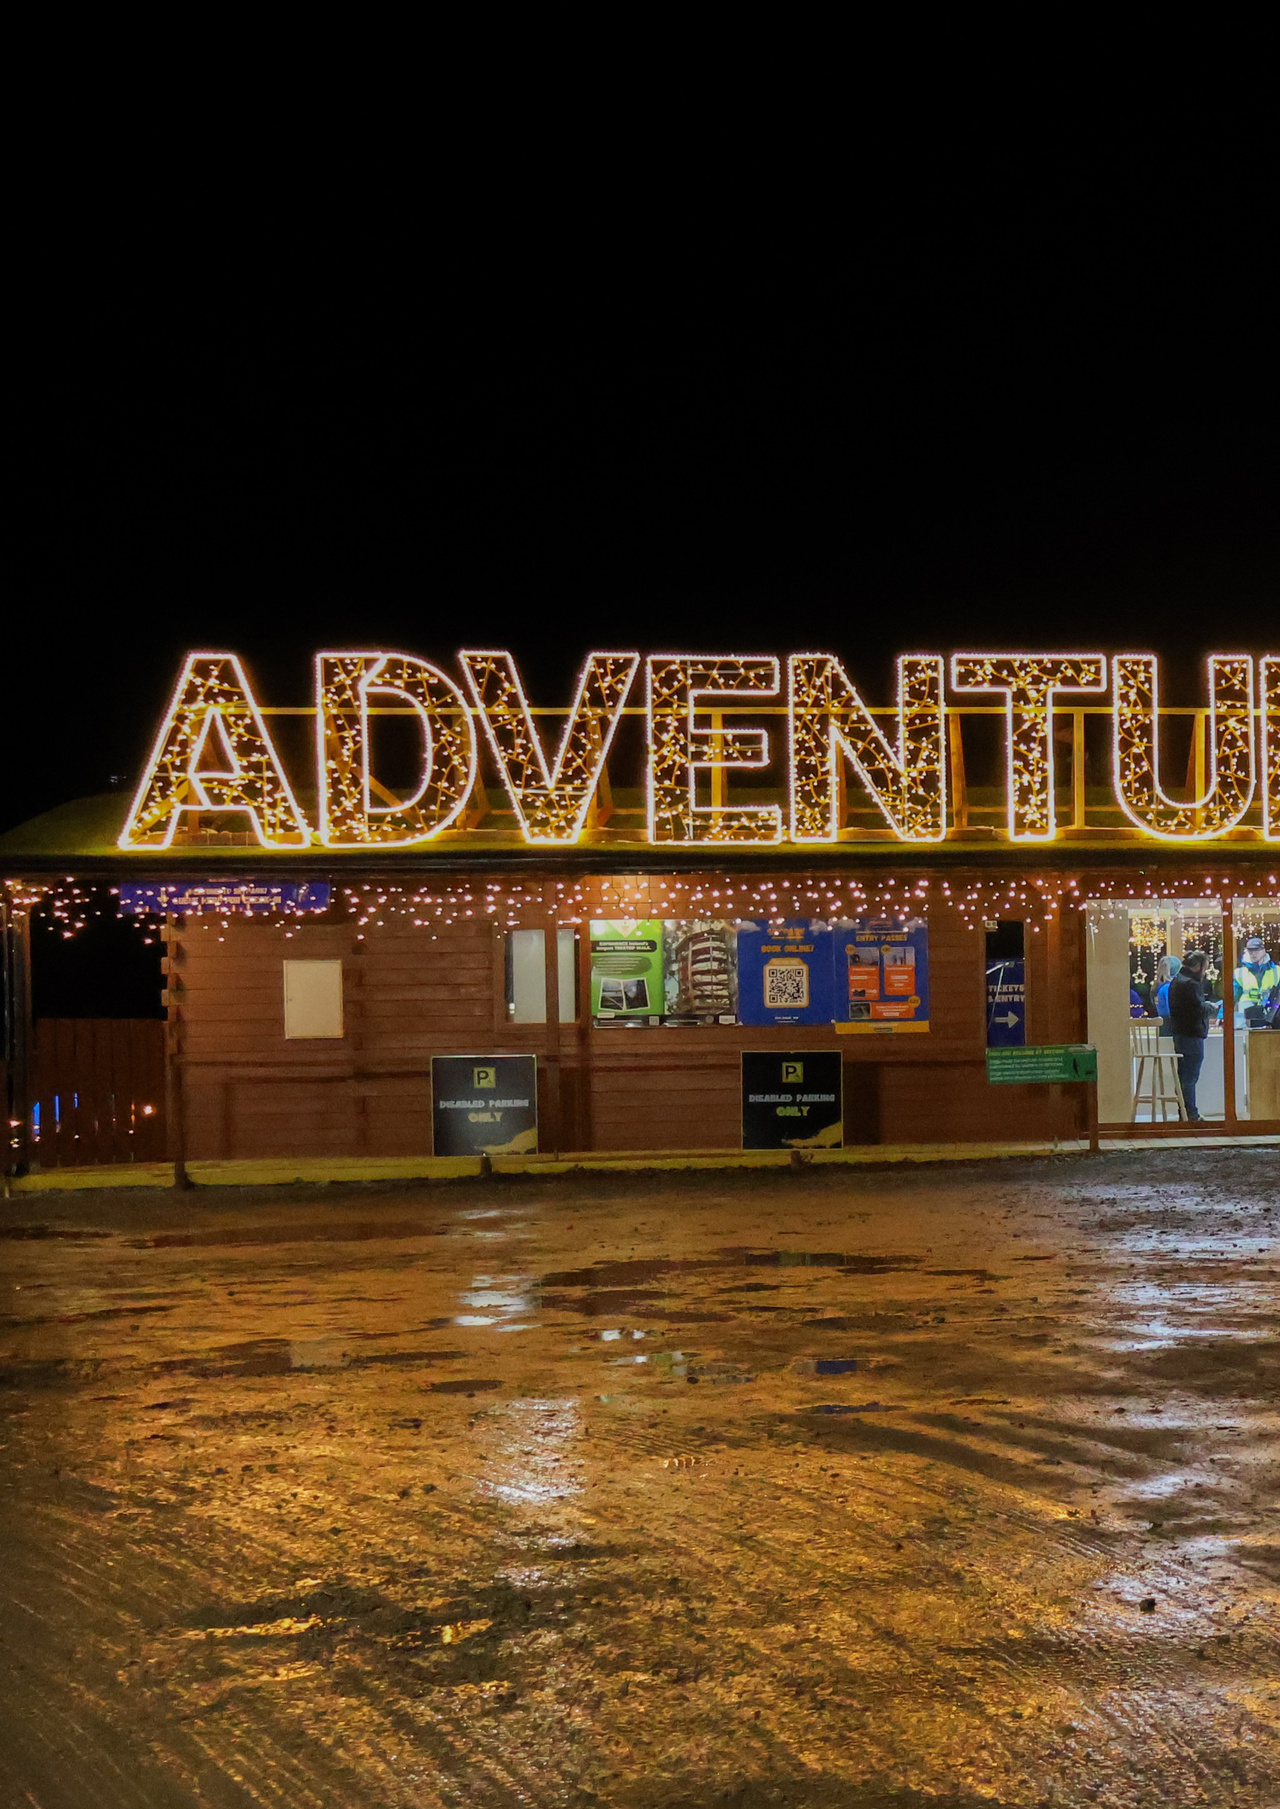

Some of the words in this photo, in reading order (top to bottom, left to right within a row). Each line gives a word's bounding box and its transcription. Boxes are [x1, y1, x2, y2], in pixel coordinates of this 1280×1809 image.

[477, 1070, 489, 1085] P
[786, 1065, 797, 1080] P
[749, 1094, 792, 1102] DISABLED
[796, 1094, 835, 1102] PARKING
[439, 1100, 485, 1108] DISABLED
[488, 1099, 529, 1107] PARKING
[776, 1106, 810, 1116] ONLY
[468, 1112, 503, 1122] ONLY
